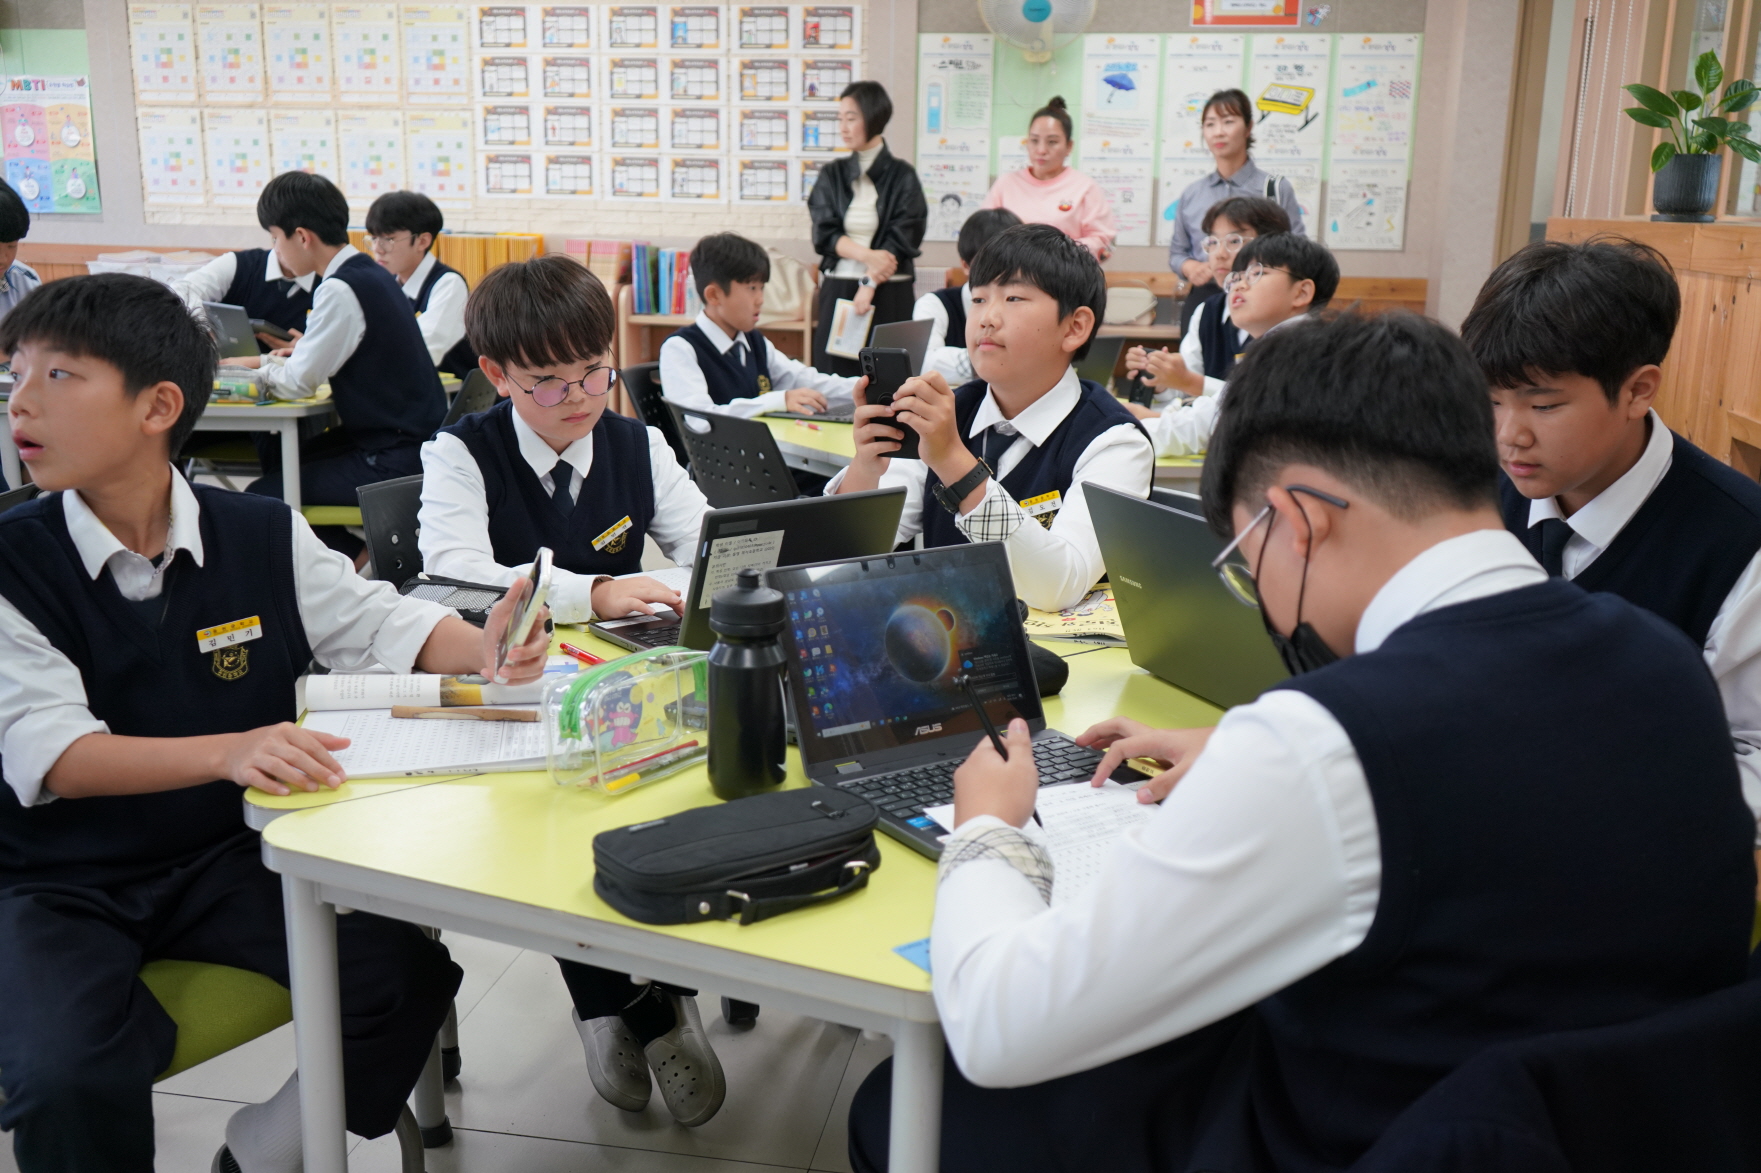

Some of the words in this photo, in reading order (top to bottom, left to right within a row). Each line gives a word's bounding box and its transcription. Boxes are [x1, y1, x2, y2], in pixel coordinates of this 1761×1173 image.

[11, 79, 46, 91] MBTI
[1119, 575, 1143, 589] SAMSUNG
[914, 722, 943, 736] ASUS
